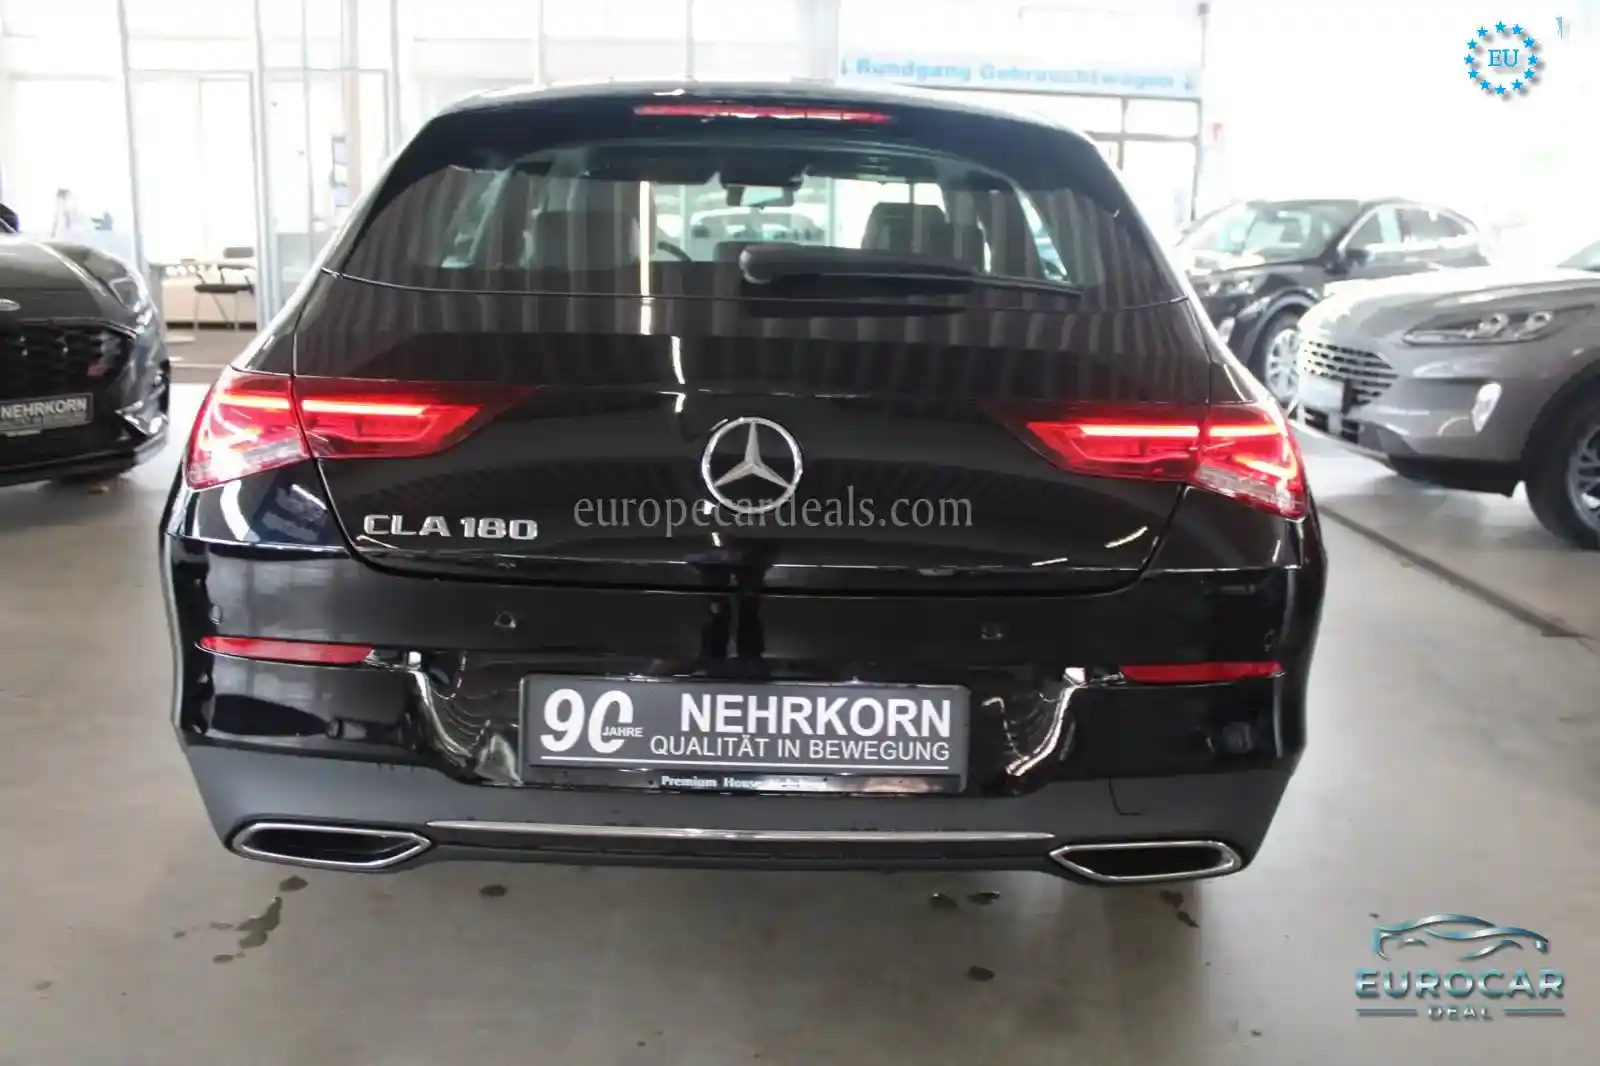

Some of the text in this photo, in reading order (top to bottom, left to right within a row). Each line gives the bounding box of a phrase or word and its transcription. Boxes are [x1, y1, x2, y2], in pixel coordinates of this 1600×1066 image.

[856, 57, 971, 84] Rundgang
[1, 398, 87, 420] NEHRKORN
[363, 514, 538, 540] CLA 180
[540, 688, 634, 754] 90
[680, 693, 951, 738] NEHRKORN
[602, 726, 644, 738] JAHRE
[650, 734, 950, 761] QUALITÄT IN BEWEGUNG
[661, 776, 717, 788] Premium
